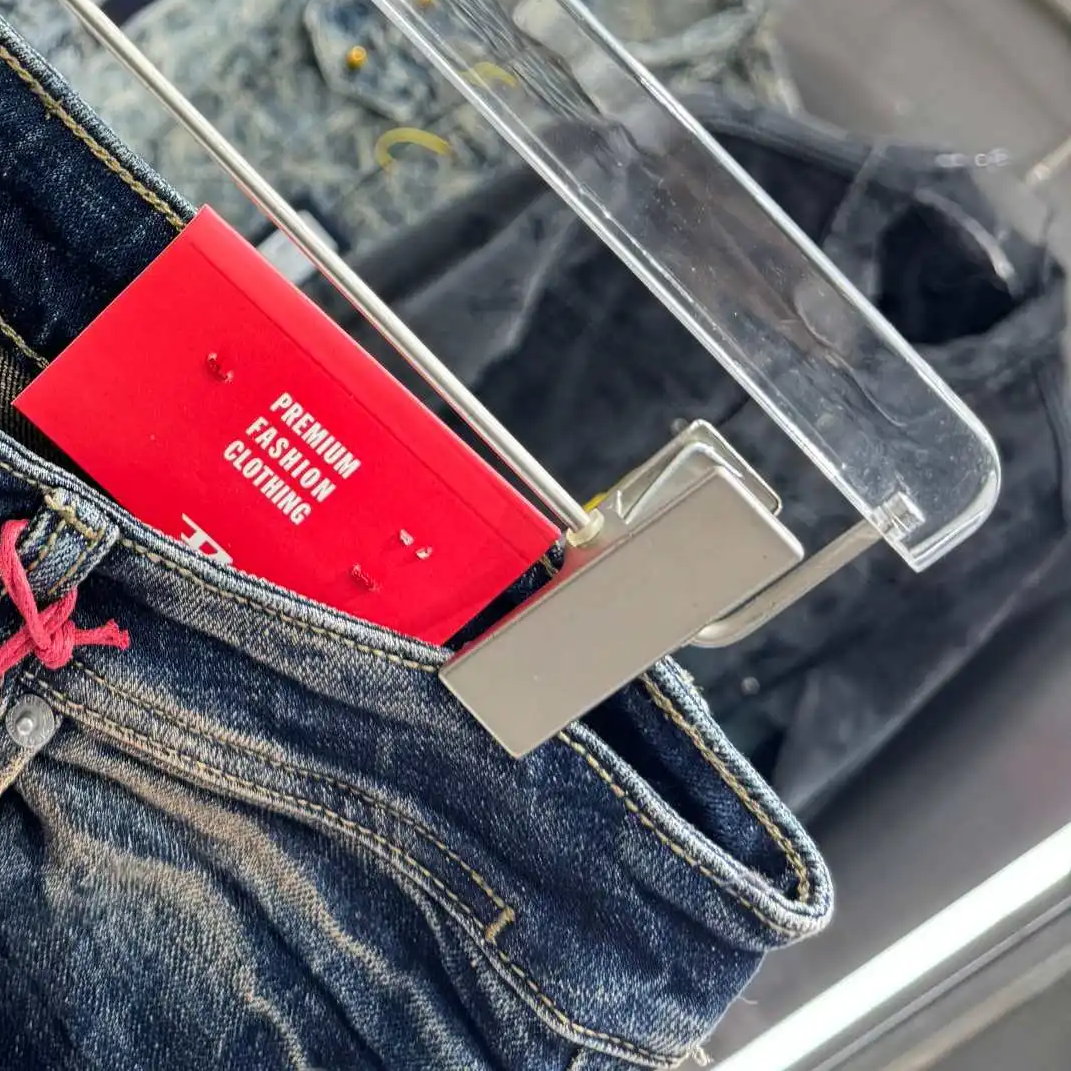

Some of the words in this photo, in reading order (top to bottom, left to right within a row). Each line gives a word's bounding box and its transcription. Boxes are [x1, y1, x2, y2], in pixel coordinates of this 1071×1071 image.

[245, 416, 337, 503] FASHION
[269, 391, 362, 480] PREMIUM
[223, 440, 312, 526] CLOTHING
